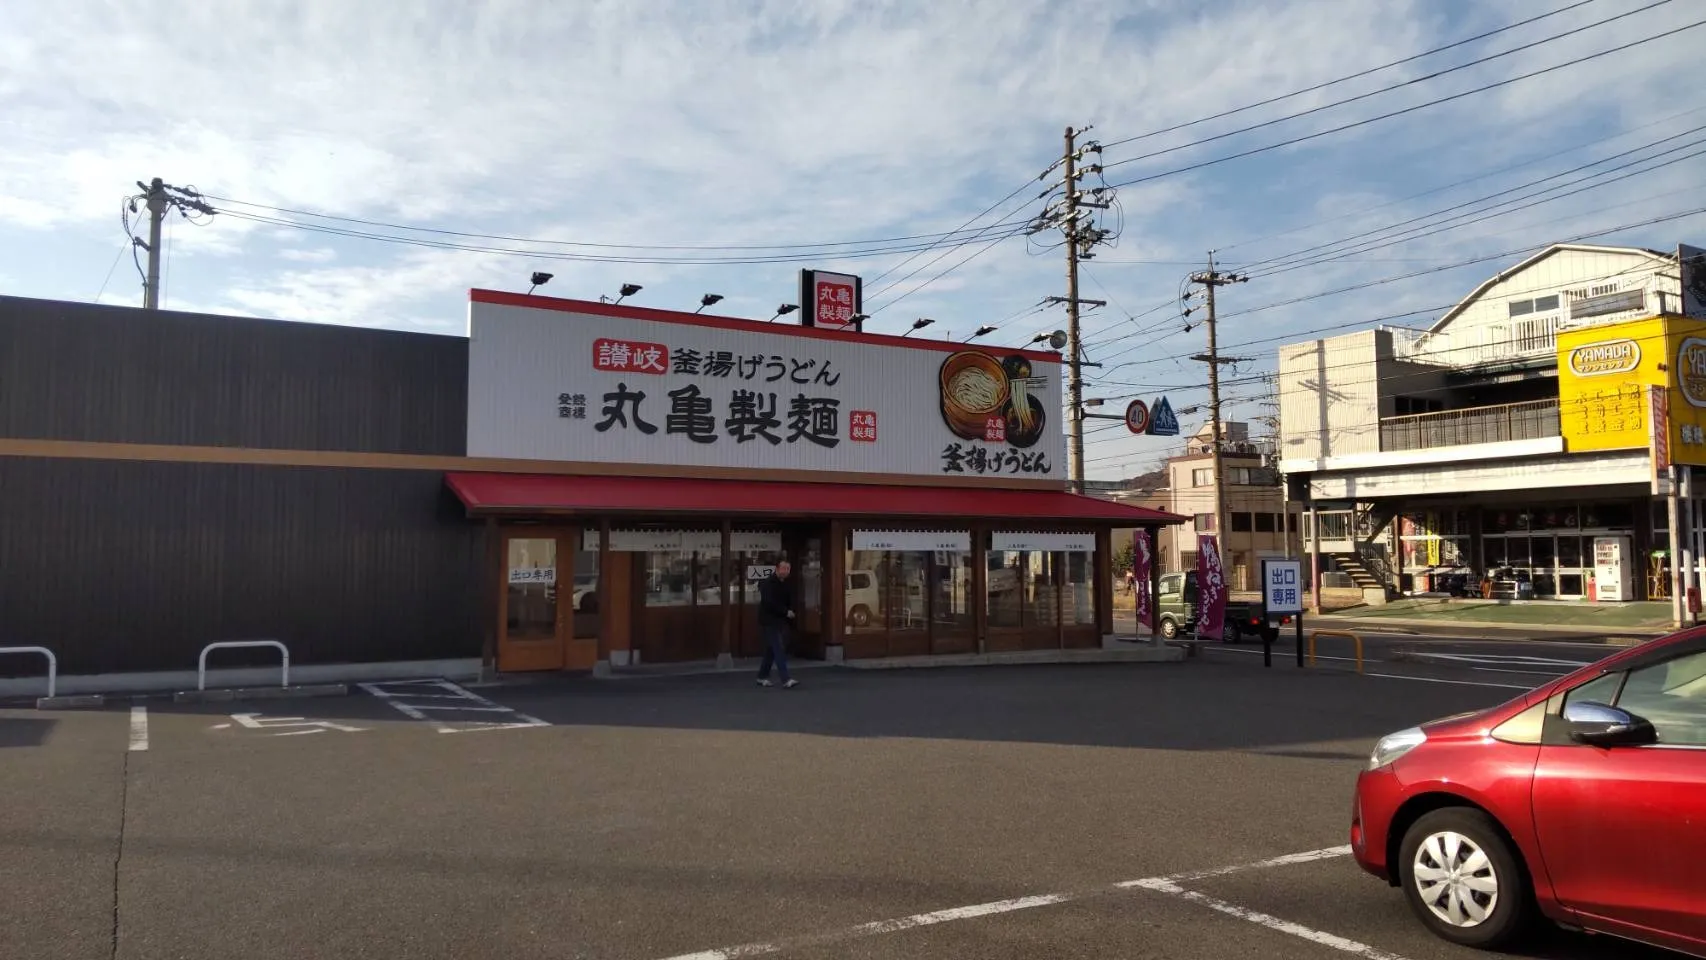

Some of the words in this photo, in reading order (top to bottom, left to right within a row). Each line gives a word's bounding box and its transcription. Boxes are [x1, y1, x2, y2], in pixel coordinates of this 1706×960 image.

[820, 286, 851, 305] 丸亀
[600, 343, 665, 371] 讃岐
[1577, 344, 1632, 362] YAMADA
[671, 347, 841, 387] 釜揚げうどん
[594, 382, 841, 449] 丸亀製麺
[852, 413, 875, 427] 丸亀
[986, 418, 1005, 429] 丸亀
[1131, 409, 1144, 425] 40
[852, 426, 875, 439] 製麺
[940, 442, 1052, 475] 釜揚げうどん
[510, 569, 553, 581] 出口専用
[751, 567, 773, 578] 入口
[1272, 568, 1296, 585] 出口
[1272, 588, 1296, 605] 専用
